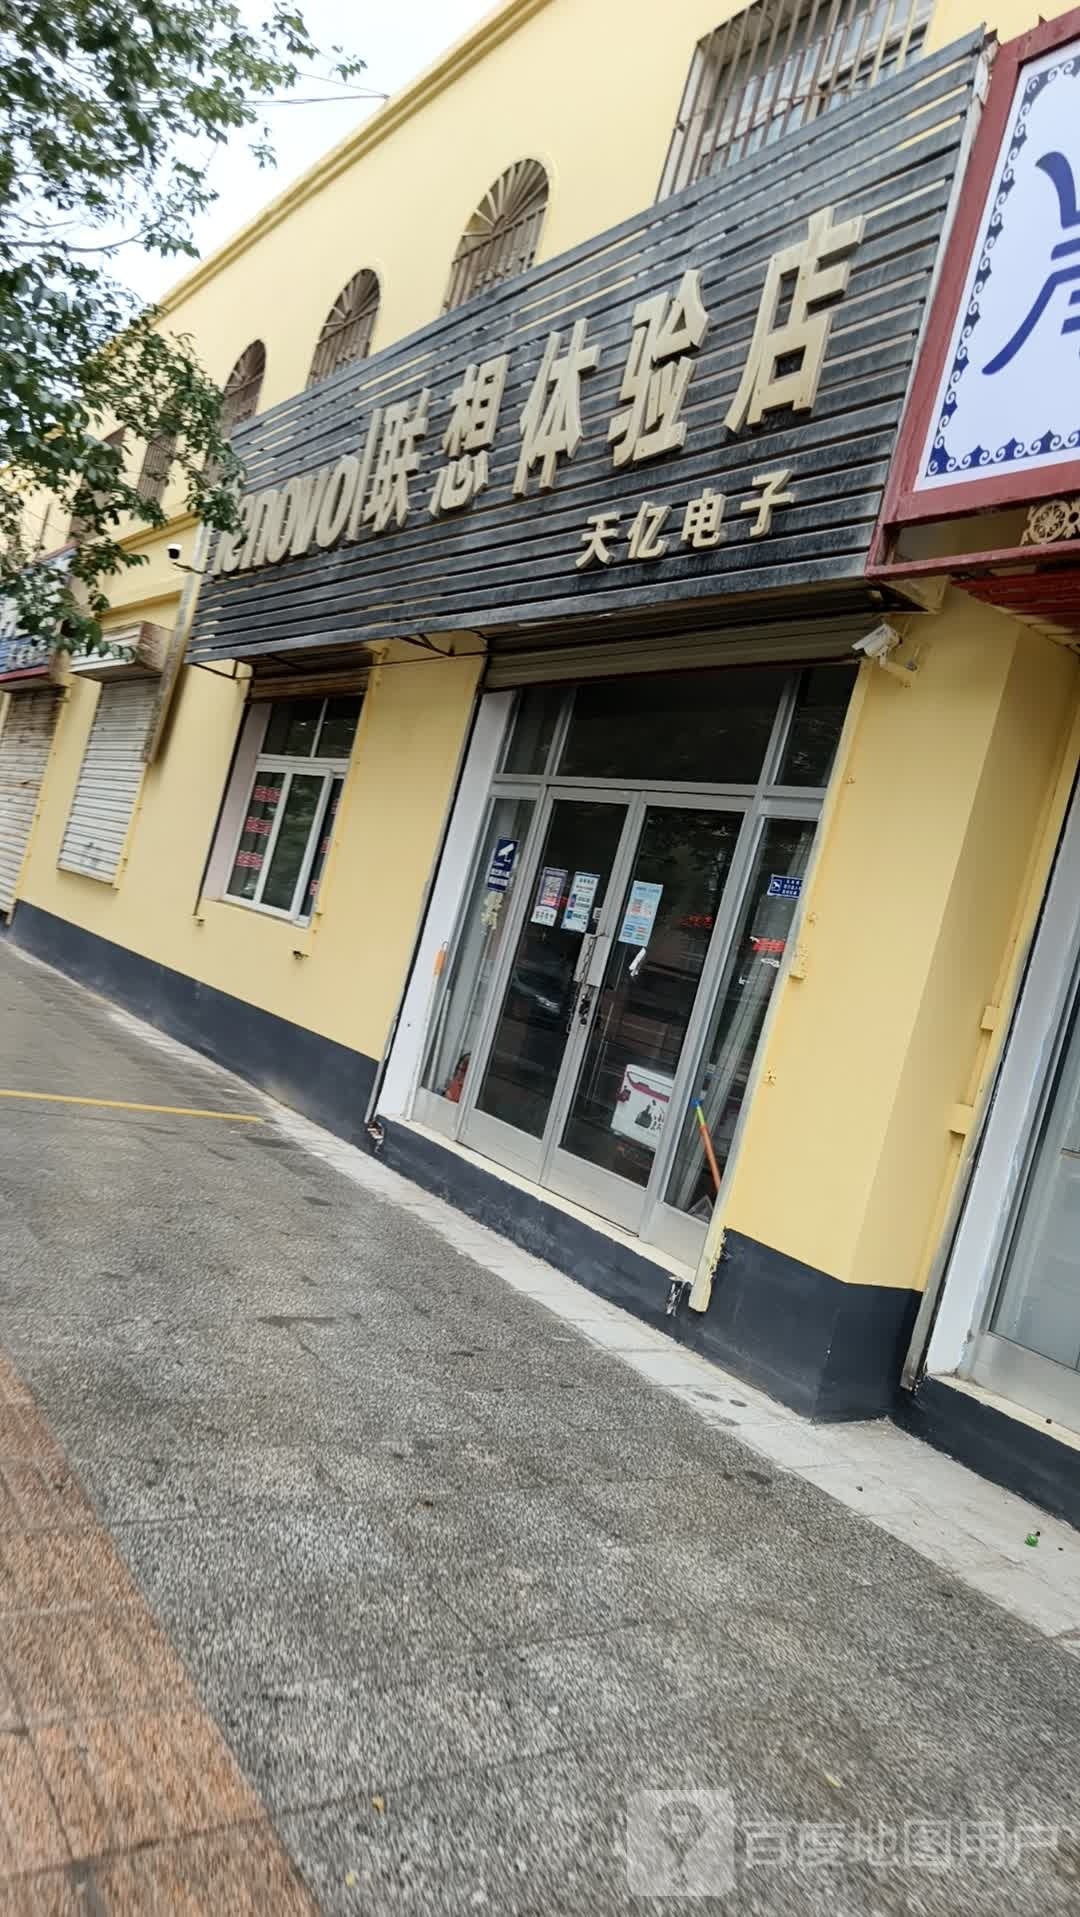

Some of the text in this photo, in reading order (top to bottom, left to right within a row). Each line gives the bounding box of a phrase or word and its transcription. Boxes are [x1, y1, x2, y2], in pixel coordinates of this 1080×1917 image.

[363, 206, 866, 532] 联想体验店
[576, 469, 794, 568] 天亿电子
